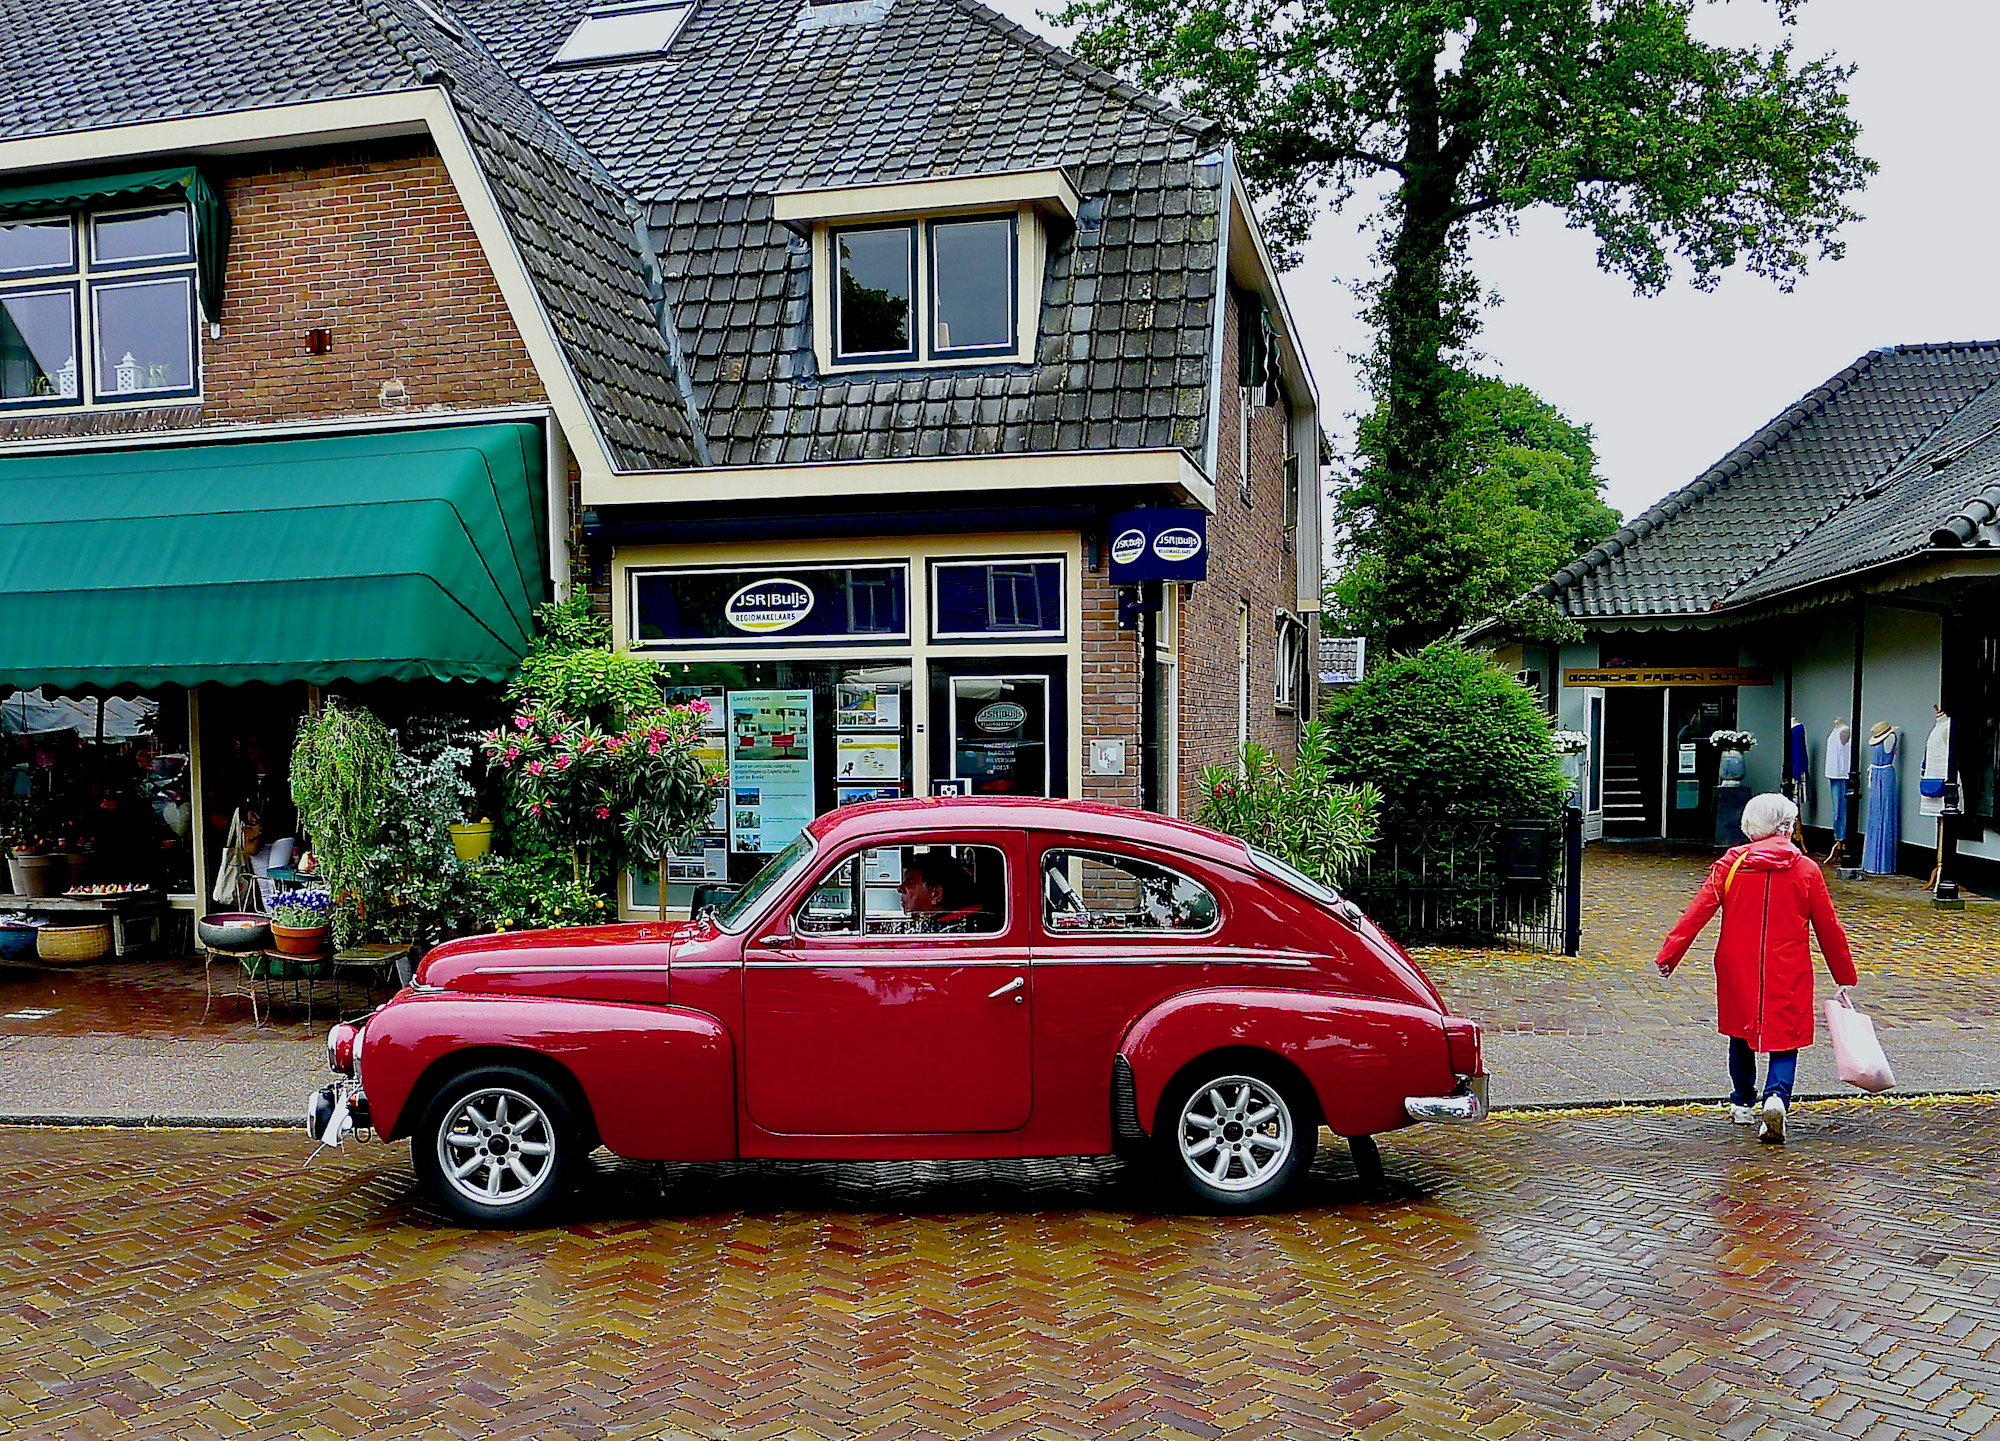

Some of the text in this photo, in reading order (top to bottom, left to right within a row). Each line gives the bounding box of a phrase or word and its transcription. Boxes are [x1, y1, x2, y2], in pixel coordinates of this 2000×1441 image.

[736, 592, 808, 608] JSR|Buijs
[735, 613, 796, 622] REGIOMAKELAARS
[1643, 673, 1704, 682] FASHION
[813, 892, 844, 903] rs.nl
